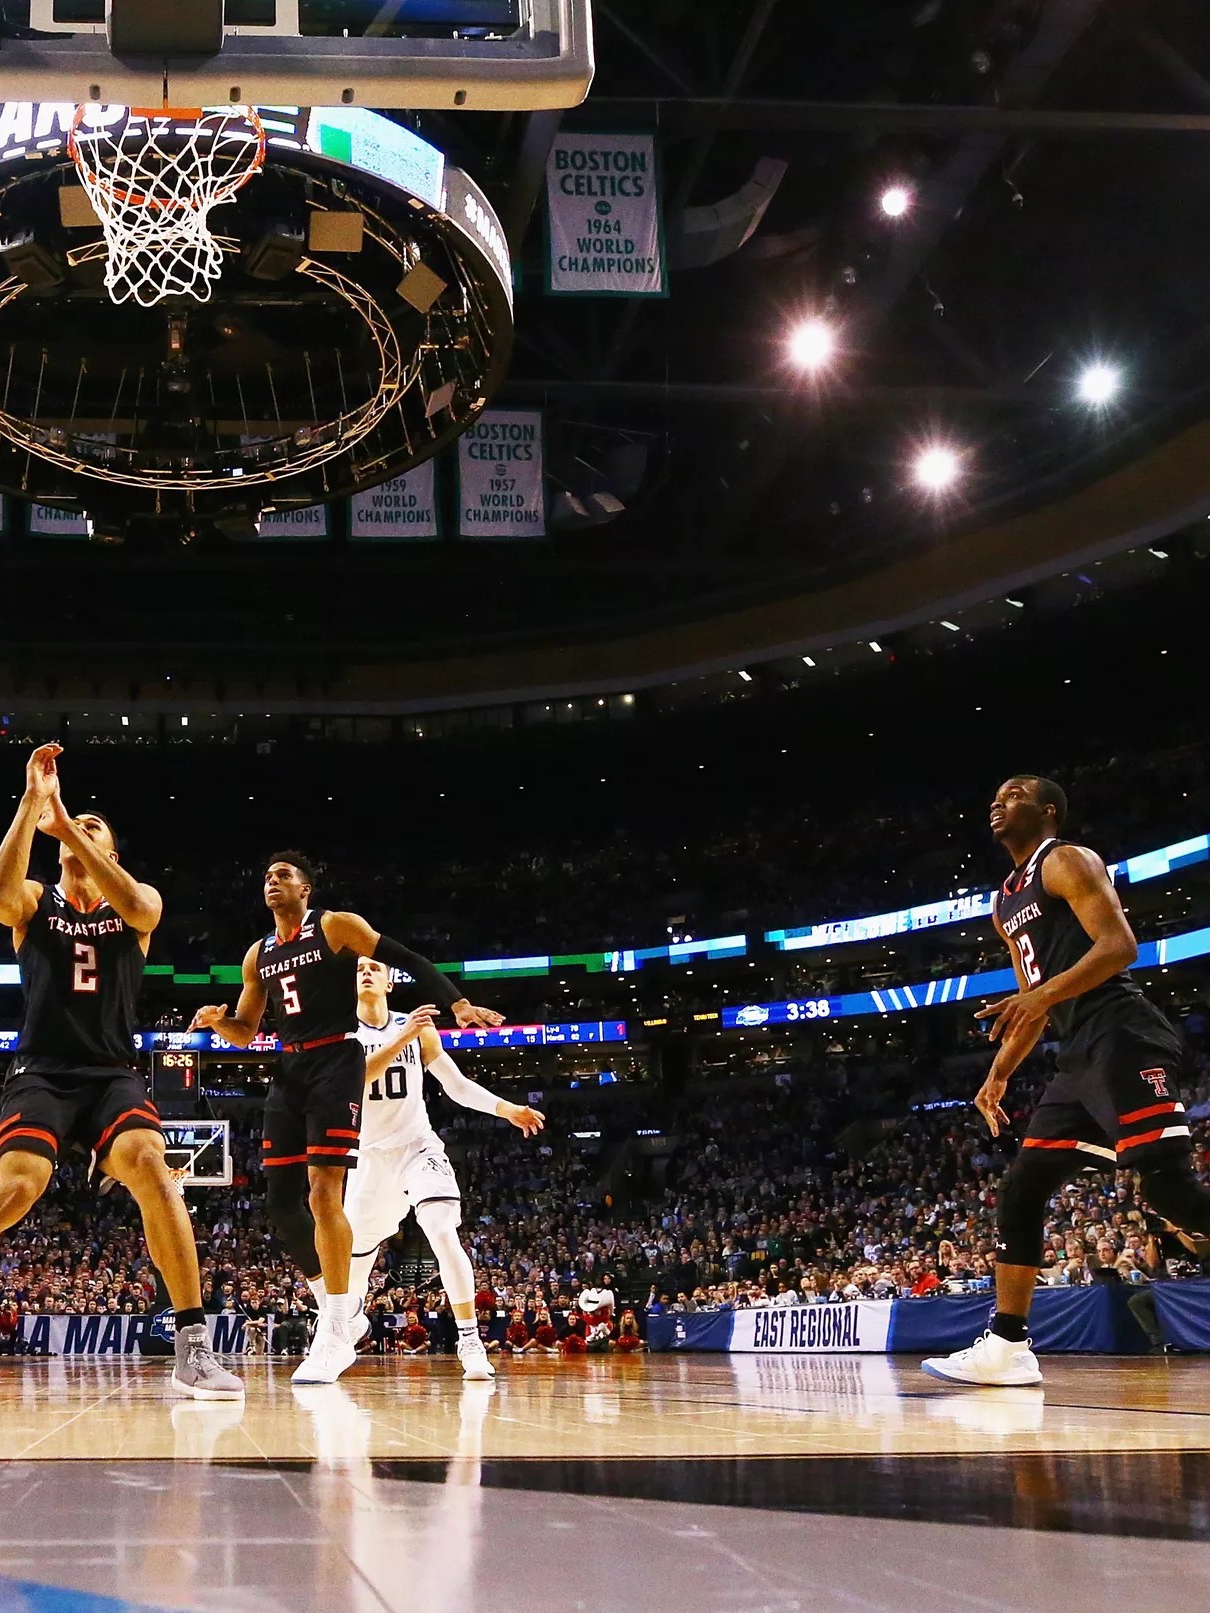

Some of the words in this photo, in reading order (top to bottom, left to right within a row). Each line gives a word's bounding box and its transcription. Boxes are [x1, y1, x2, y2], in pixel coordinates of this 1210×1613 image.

[555, 151, 646, 172] BOSTON
[560, 174, 645, 197] CELTICS
[586, 219, 622, 234] 1964
[577, 238, 635, 255] WORLD
[558, 256, 655, 274] CHAMPIONS
[468, 442, 533, 461] CELTICS
[490, 479, 516, 491] 1957
[372, 495, 417, 508] WORLD
[480, 494, 525, 507] WORLD
[262, 509, 319, 523] AMPIONS
[357, 509, 431, 523] CHAMPIONS
[466, 509, 539, 523] CHAMPIONS
[48, 916, 89, 936] TEXAS
[89, 918, 123, 936] TECH
[74, 942, 97, 991] 2
[259, 959, 290, 980] TEXAS
[292, 949, 322, 968] TECH
[280, 974, 301, 1015] 5
[787, 1000, 830, 1020] 3:38
[0, 1041, 10, 1050] 42
[503, 1036, 509, 1044] 4
[162, 1054, 193, 1067] 16:26
[369, 1066, 408, 1100] 10
[64, 1316, 143, 1354] MAR
[753, 1310, 786, 1348] EAST
[790, 1305, 860, 1348] REGIONAL
